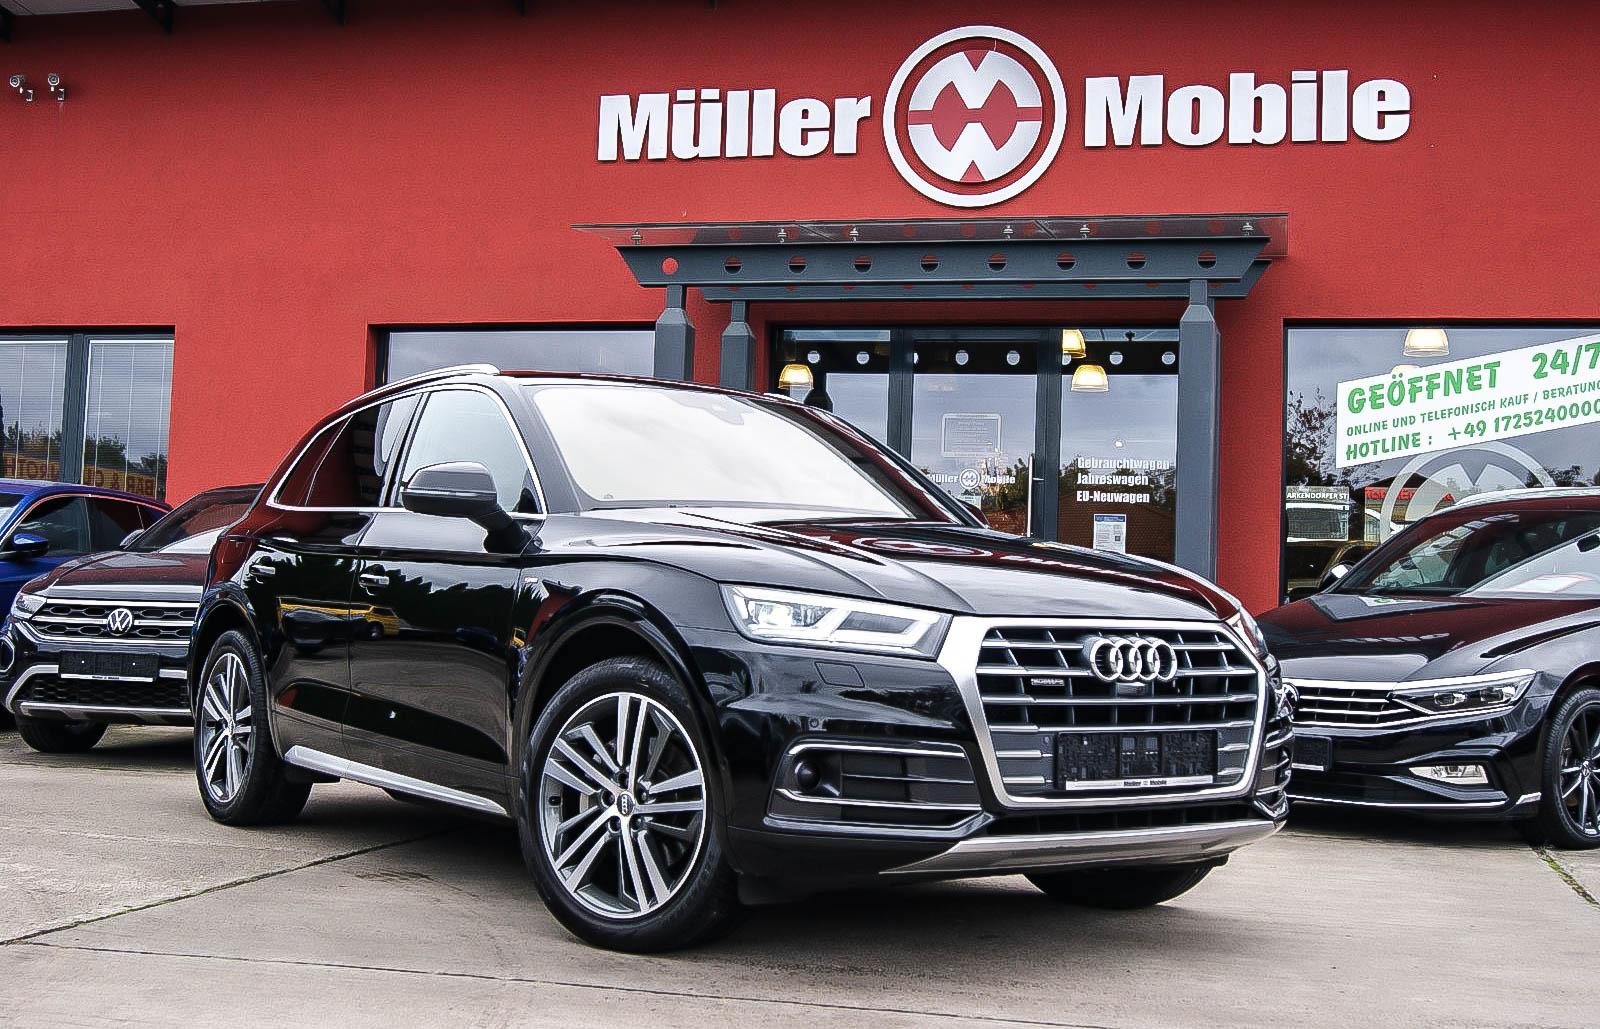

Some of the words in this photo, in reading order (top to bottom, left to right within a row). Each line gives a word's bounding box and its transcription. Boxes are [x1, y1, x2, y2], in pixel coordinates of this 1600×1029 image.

[597, 87, 872, 162] Müller
[1085, 69, 1413, 147] Mobile
[1347, 361, 1501, 414] GEÖFFNET
[1532, 342, 1600, 379] 24/7
[1346, 420, 1388, 436] ONLINE
[1392, 415, 1416, 428] UND
[1420, 400, 1496, 424] TELEFONISCH
[1500, 394, 1529, 408] KAUF
[1346, 432, 1421, 460] HOTLINE
[1448, 420, 1487, 440] +49
[1078, 457, 1169, 470] Gebrauchtwagen
[981, 474, 1016, 484] Mobile
[1077, 473, 1149, 486] Jahreswagen
[1077, 490, 1150, 503] EU-Neuwagen
